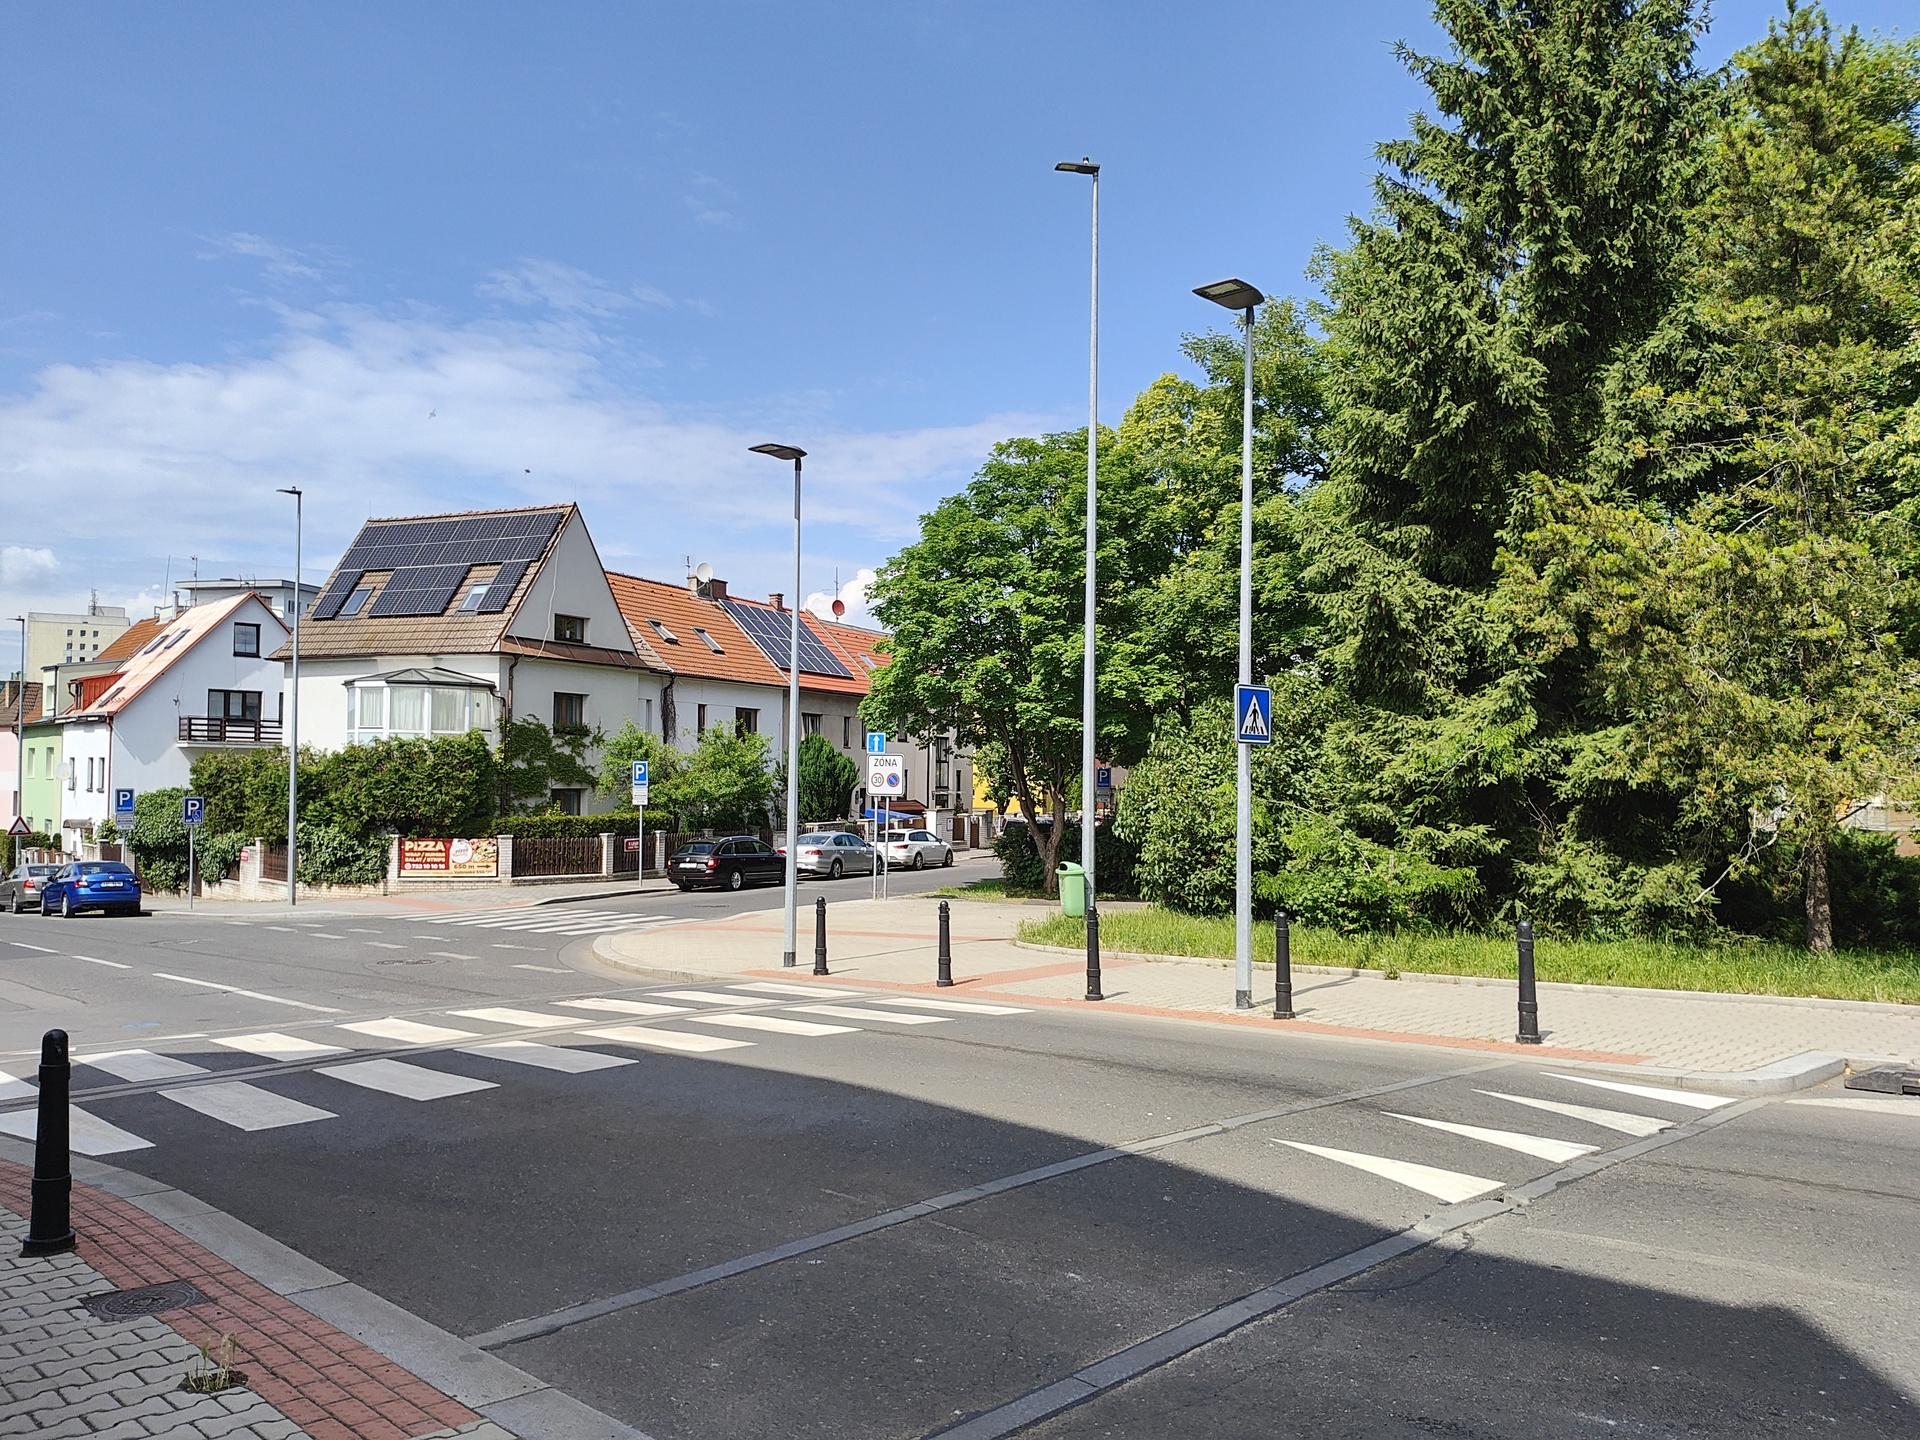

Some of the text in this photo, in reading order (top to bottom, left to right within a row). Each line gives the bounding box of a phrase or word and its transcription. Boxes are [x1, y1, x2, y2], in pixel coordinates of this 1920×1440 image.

[874, 757, 897, 766] ZÓNA
[635, 764, 645, 780] P
[1099, 770, 1108, 782] P
[874, 776, 882, 784] 30
[119, 791, 130, 806] P
[187, 800, 199, 816] P
